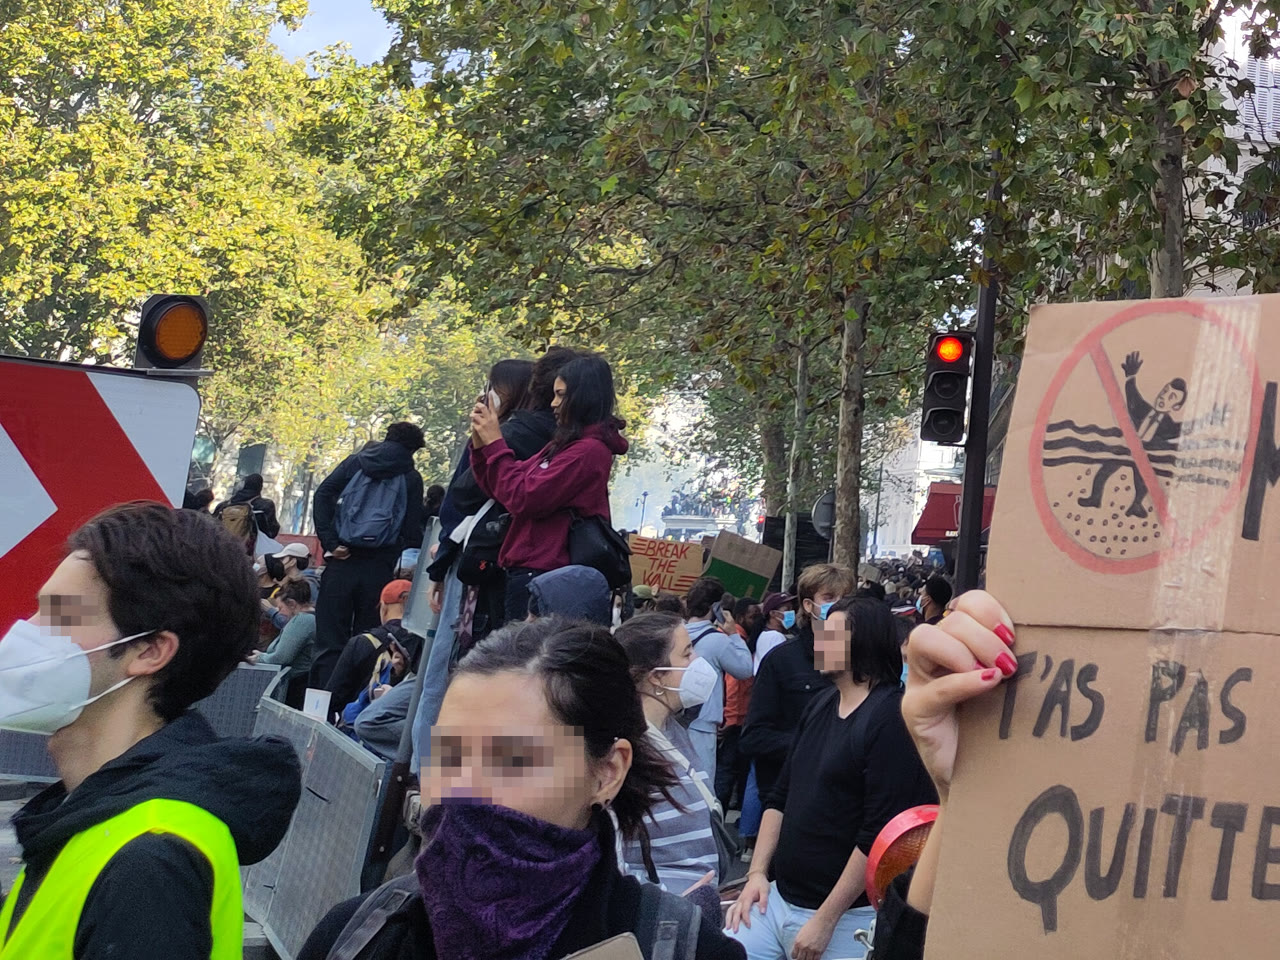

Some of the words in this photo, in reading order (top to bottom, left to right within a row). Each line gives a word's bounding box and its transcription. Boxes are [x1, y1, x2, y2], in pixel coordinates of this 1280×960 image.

[645, 541, 690, 559] BREAK
[649, 558, 679, 573] THE
[643, 570, 674, 591] WALL
[999, 651, 1105, 741] T'AS
[1144, 660, 1252, 756] PAS
